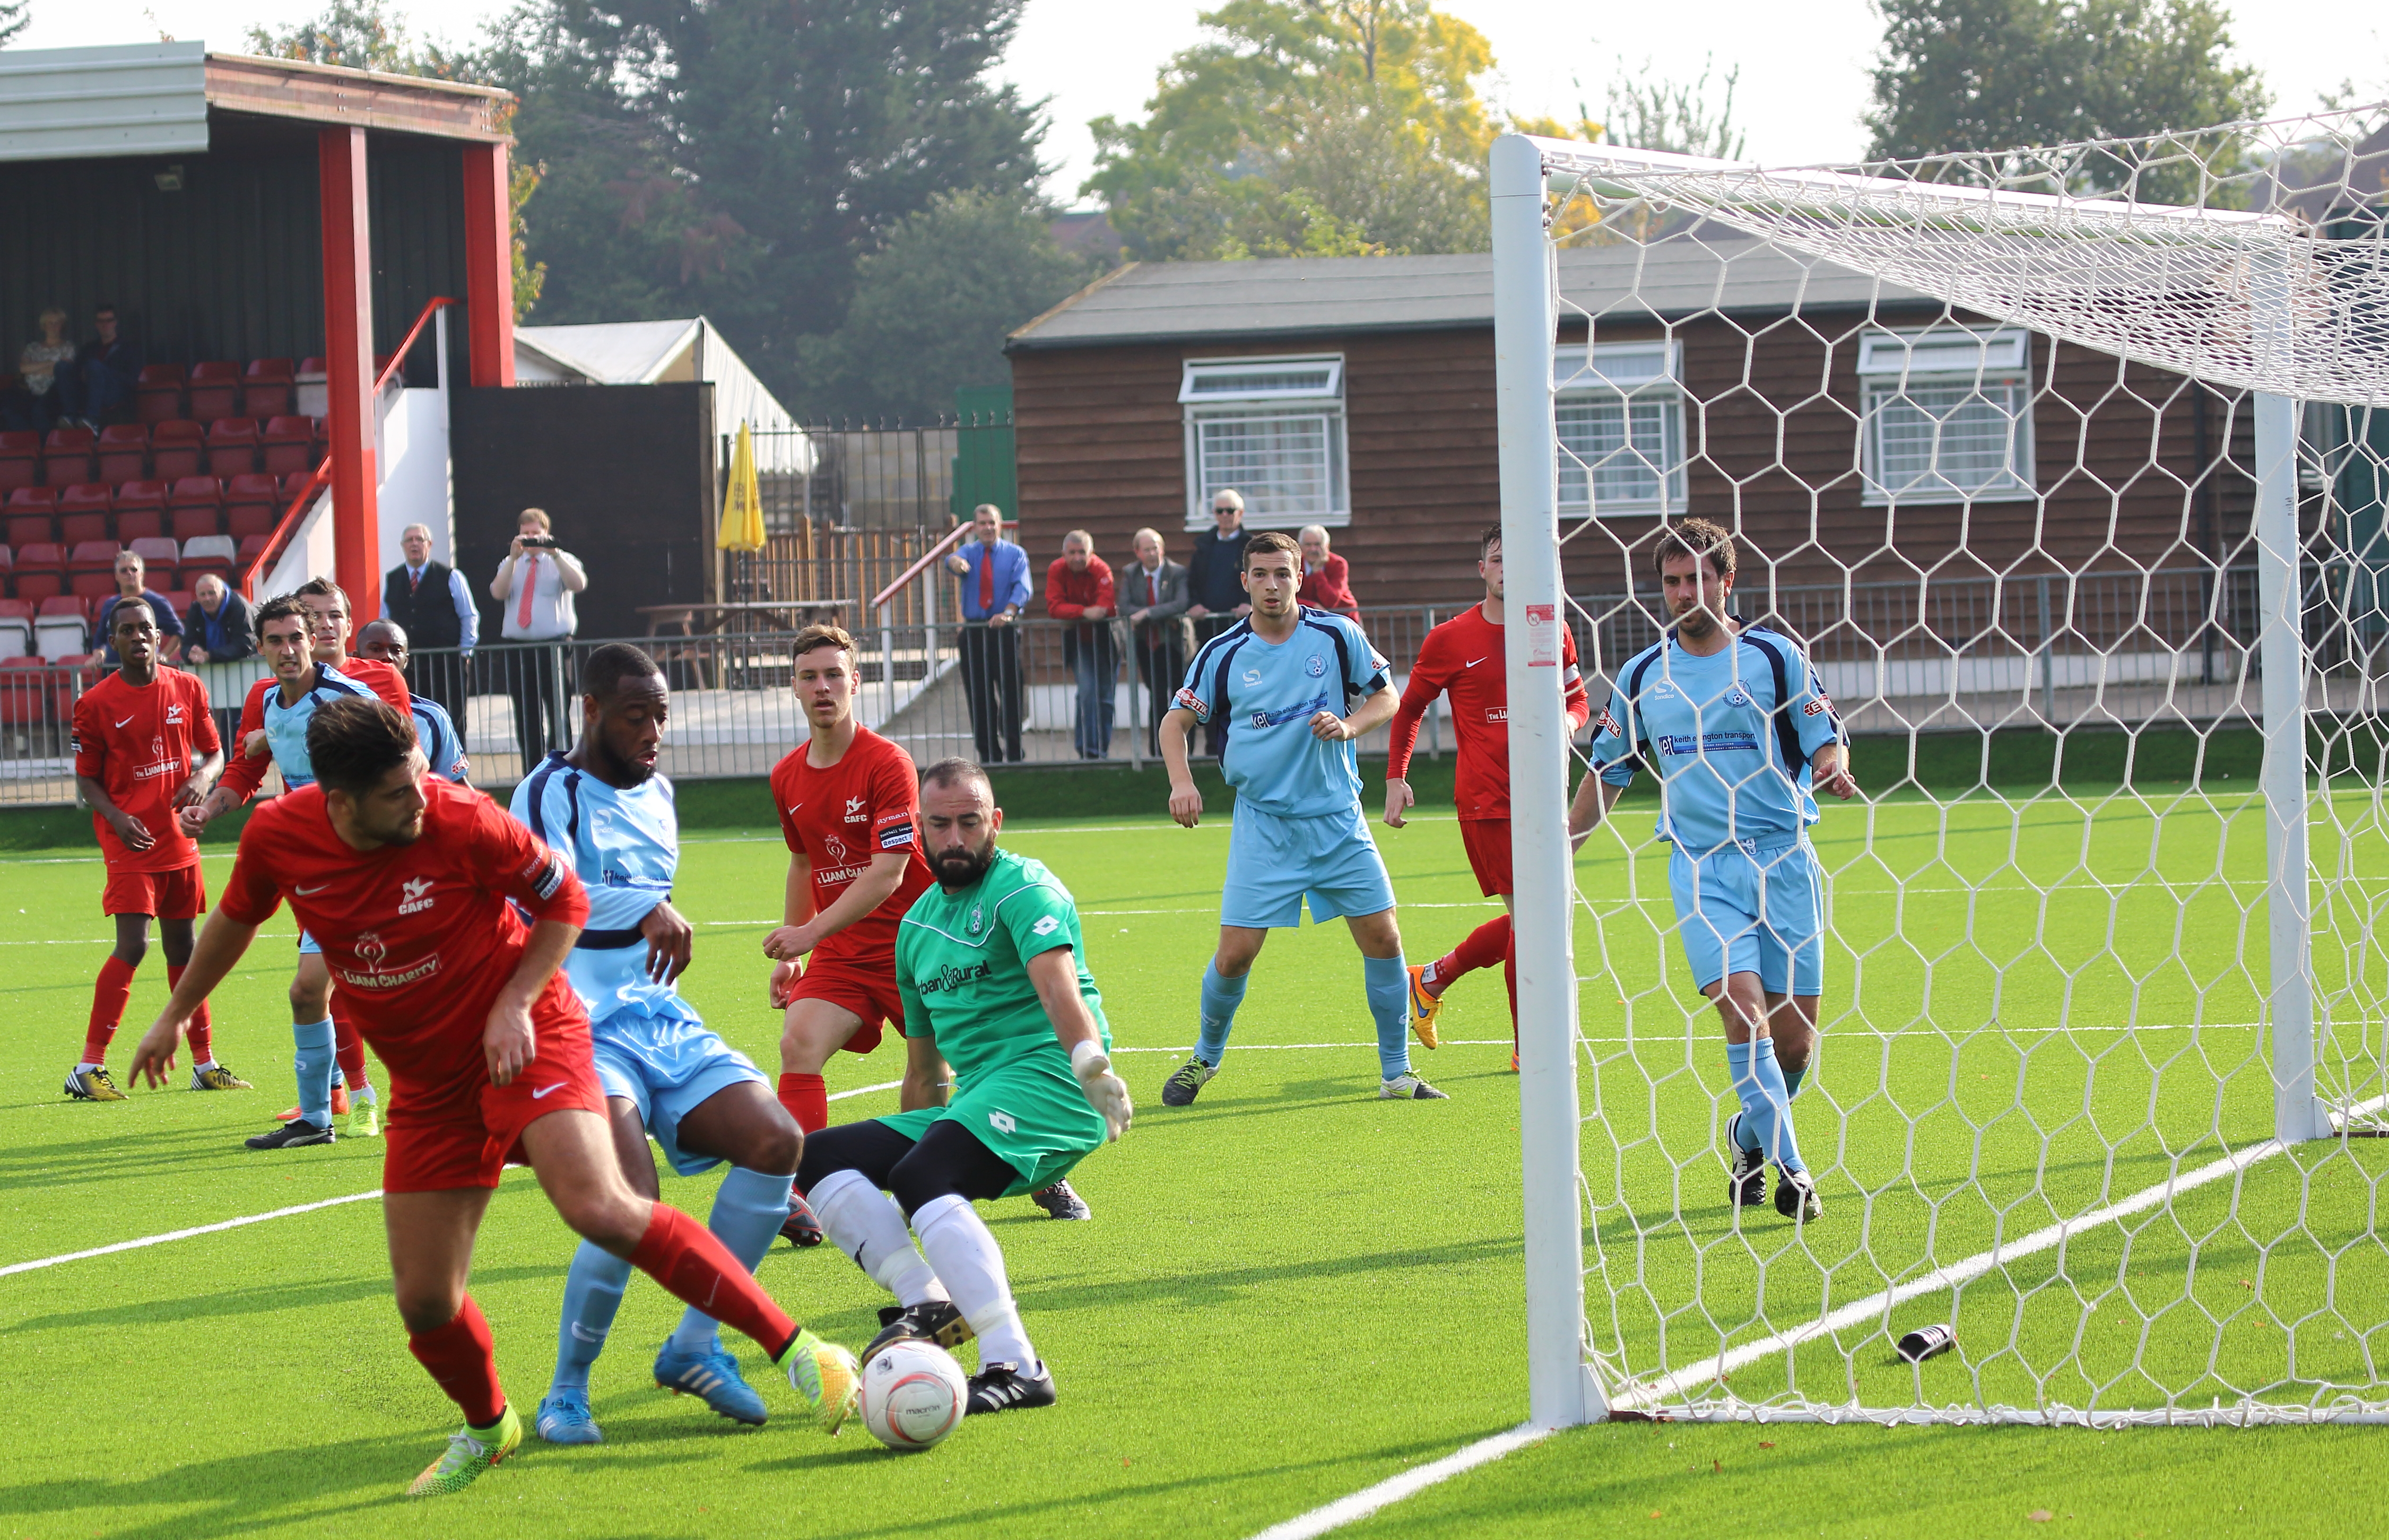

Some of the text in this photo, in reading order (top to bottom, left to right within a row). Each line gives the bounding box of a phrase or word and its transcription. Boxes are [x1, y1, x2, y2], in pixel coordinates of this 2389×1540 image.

[1283, 701, 1308, 714] elkington
[1309, 691, 1328, 704] traort
[1252, 712, 1270, 729] ket
[1674, 734, 1691, 743] keith
[1692, 732, 1723, 742] engton
[844, 814, 867, 823] CAFC
[877, 812, 909, 825] Ryman
[880, 829, 898, 838] Football
[883, 836, 908, 847] Respect
[820, 870, 847, 883] LIAM
[398, 898, 434, 915] CAFC
[343, 970, 378, 987] LIAM
[378, 960, 436, 987] CHARITY
[906, 1405, 940, 1415] macron
